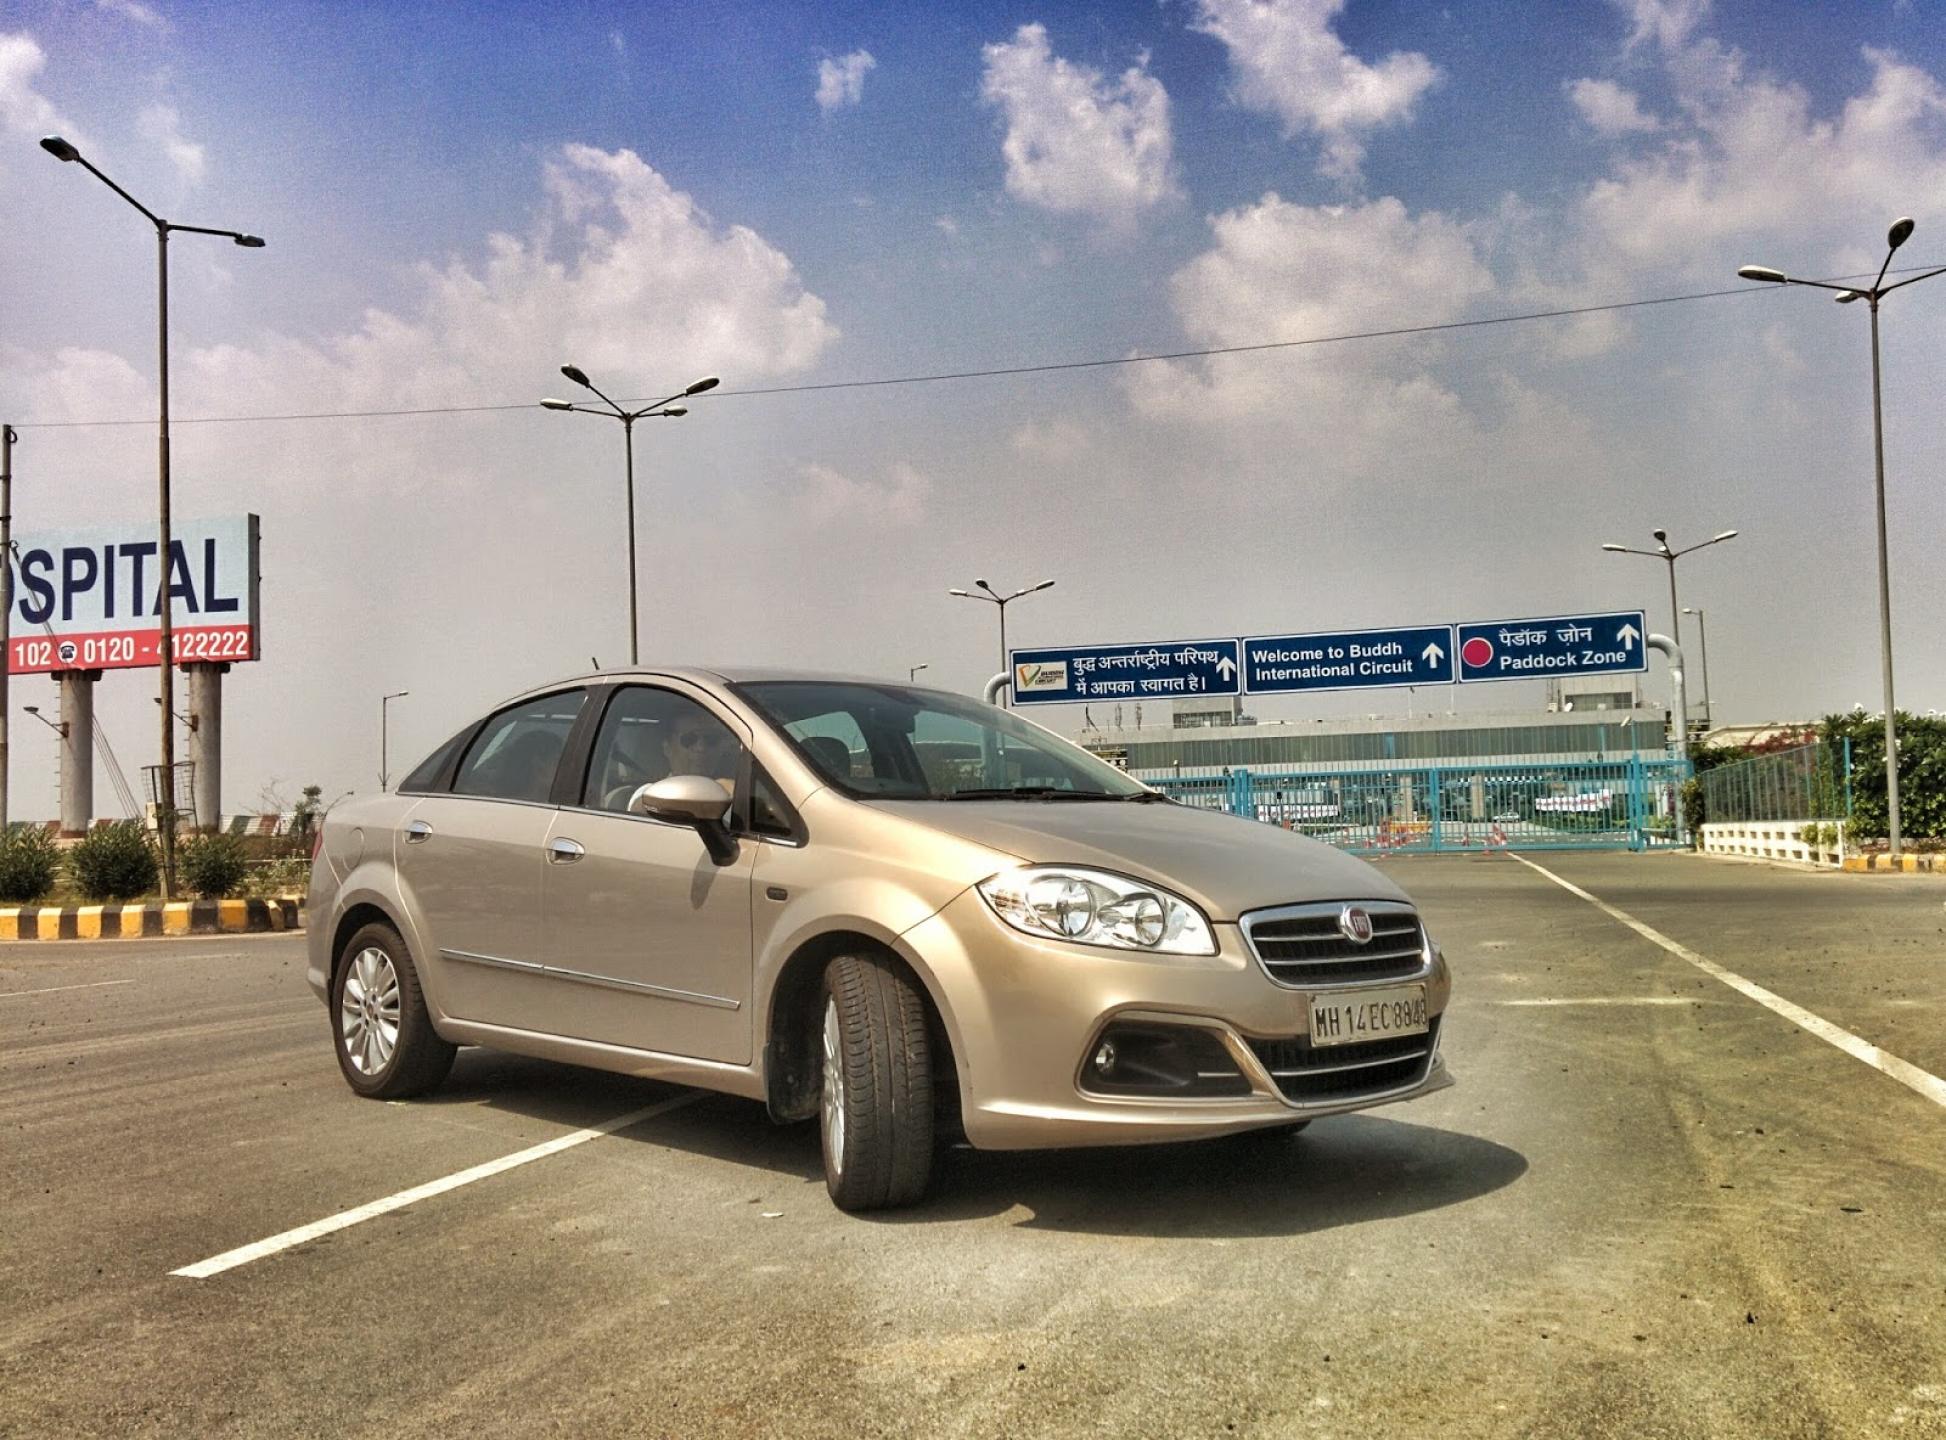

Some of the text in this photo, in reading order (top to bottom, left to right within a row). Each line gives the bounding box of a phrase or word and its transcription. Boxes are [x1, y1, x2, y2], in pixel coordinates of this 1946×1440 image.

[8, 538, 239, 625] SPITAL
[15, 641, 52, 667] 102
[83, 636, 135, 663] 0120
[156, 630, 248, 659] 122222
[1252, 642, 1402, 664] Welcome to Buddh
[1072, 656, 1096, 676] बुद्ध
[1174, 646, 1219, 666] परिपथ
[1256, 659, 1413, 681] International Circuit
[1500, 650, 1627, 671] Paddock Zone
[1075, 677, 1087, 696] में
[1090, 680, 1135, 695] आपका
[1139, 677, 1185, 693] स्वागत
